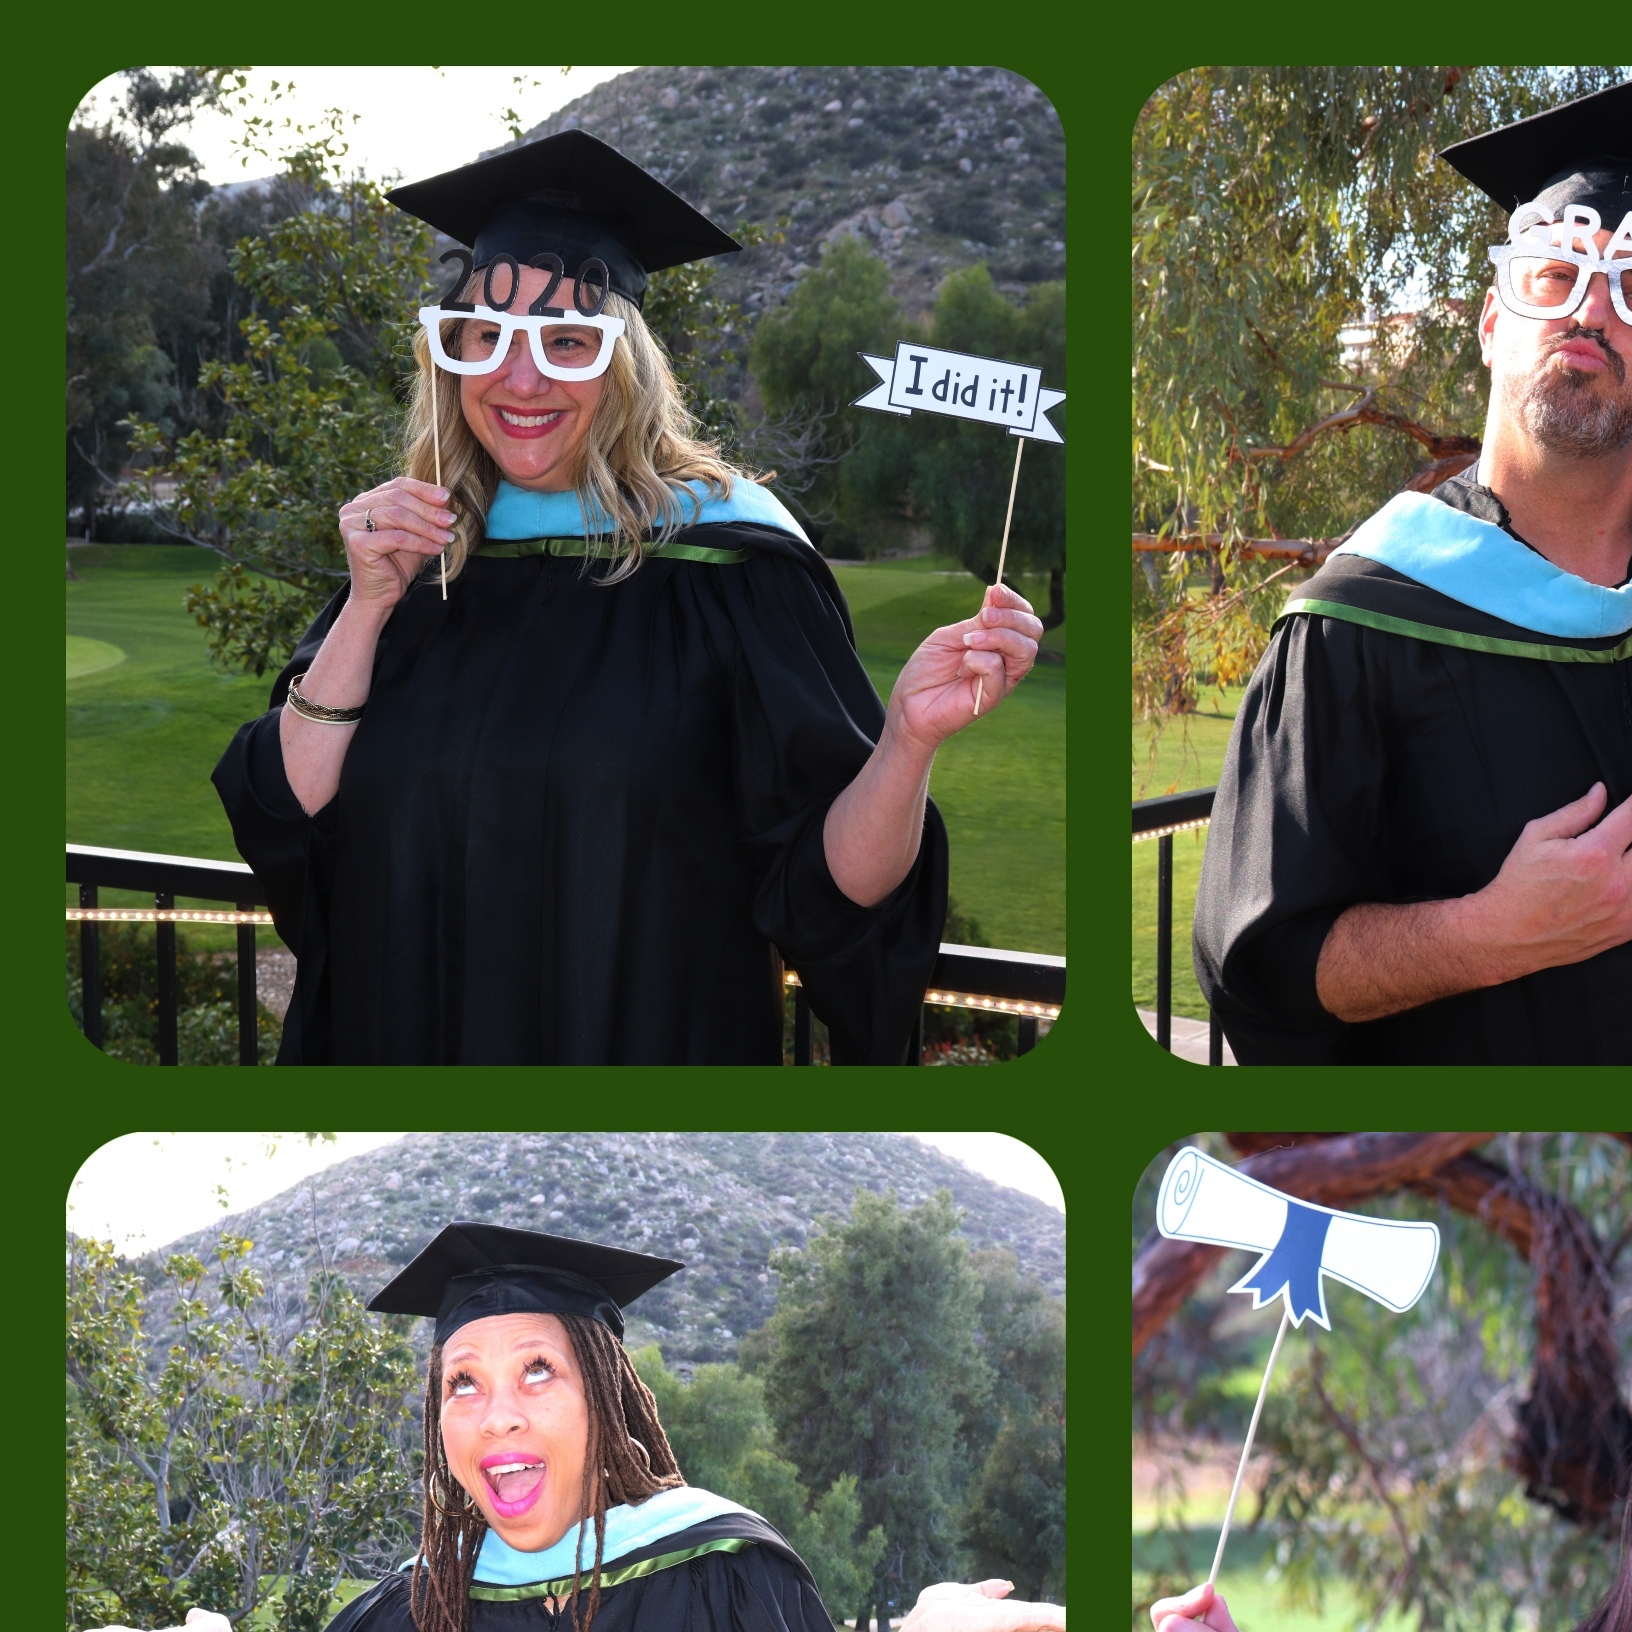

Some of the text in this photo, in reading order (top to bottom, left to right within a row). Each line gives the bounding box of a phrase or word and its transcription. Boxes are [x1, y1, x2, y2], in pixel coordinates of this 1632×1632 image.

[439, 249, 609, 318] 2020
[905, 355, 1027, 416] I did it!
